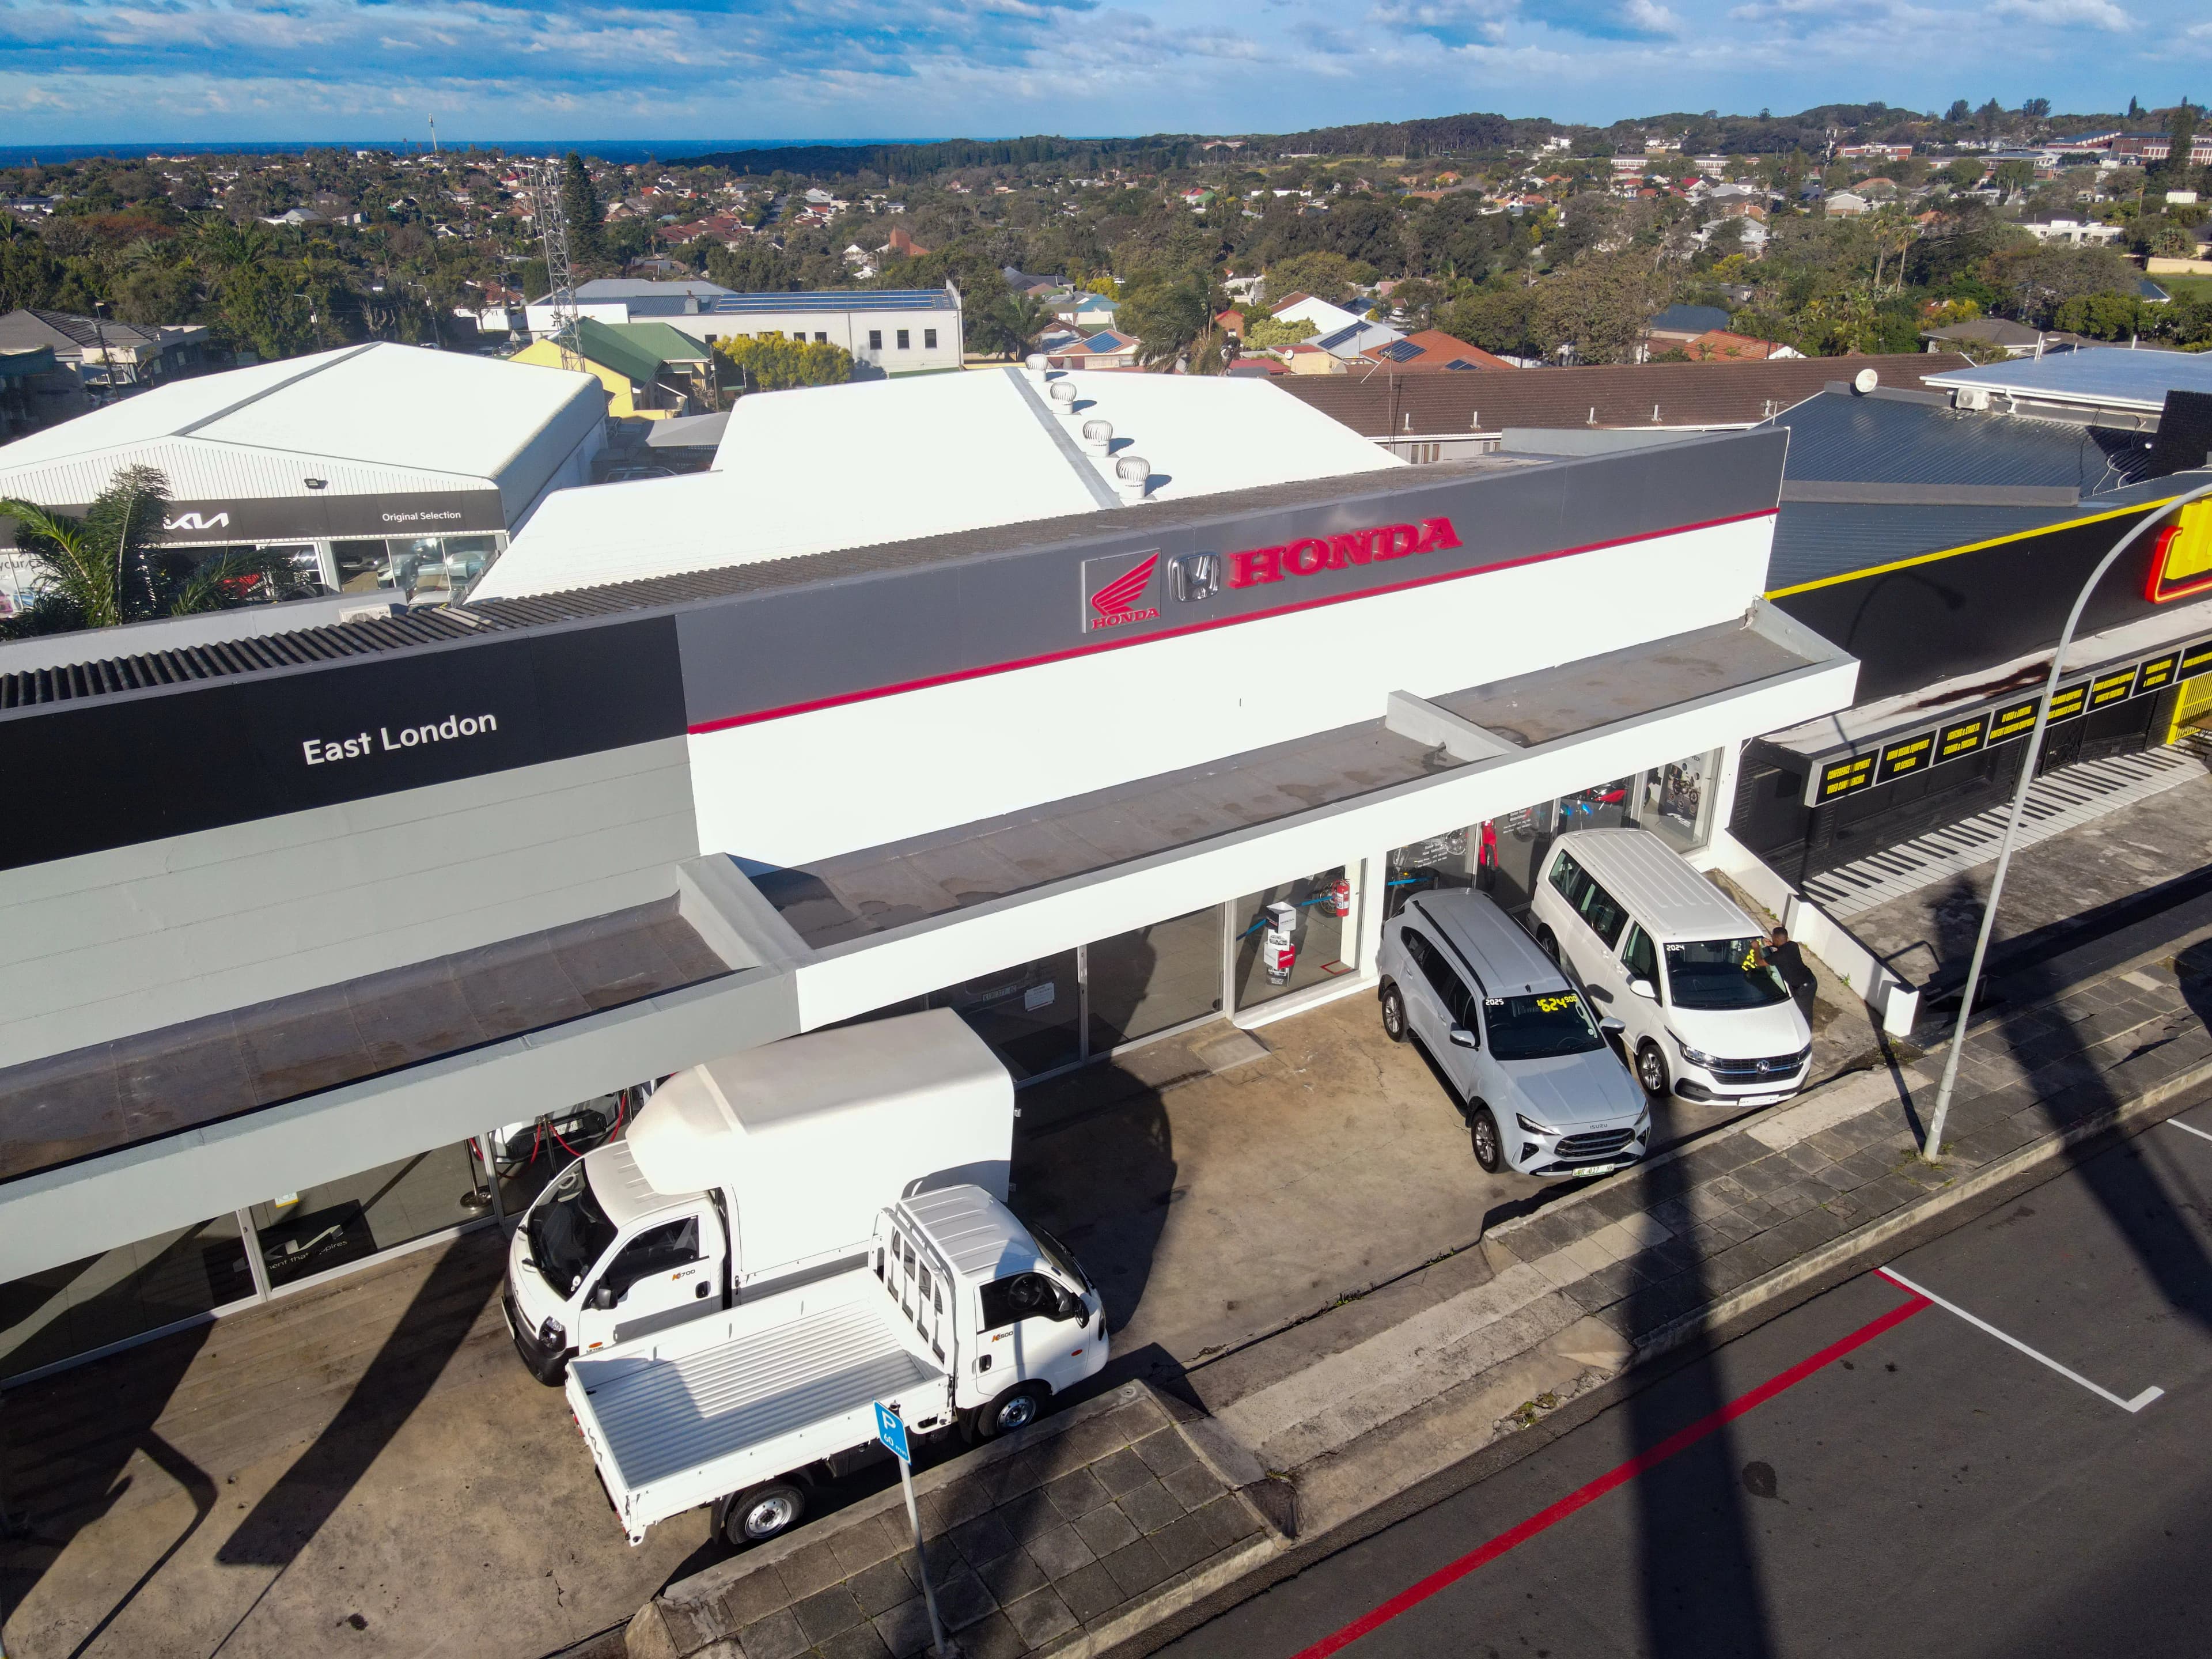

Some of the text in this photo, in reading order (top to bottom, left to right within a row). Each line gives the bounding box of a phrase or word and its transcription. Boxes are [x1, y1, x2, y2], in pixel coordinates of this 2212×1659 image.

[382, 511, 461, 522] Original Selection
[1228, 516, 1464, 590] HONDA
[1092, 607, 1160, 630] HONDA
[2018, 716, 2037, 730] EQUIPMENT
[302, 714, 498, 766] East London
[1910, 738, 1930, 753] EQUIPMENT
[1900, 756, 1916, 770] SCREENS
[1827, 764, 1851, 781] CONFERENCE
[1827, 782, 1839, 795] VIDEO
[1485, 998, 1505, 1006] 2025
[289, 1252, 309, 1263] that
[882, 1410, 896, 1430] P
[884, 1433, 908, 1457] 60 min
